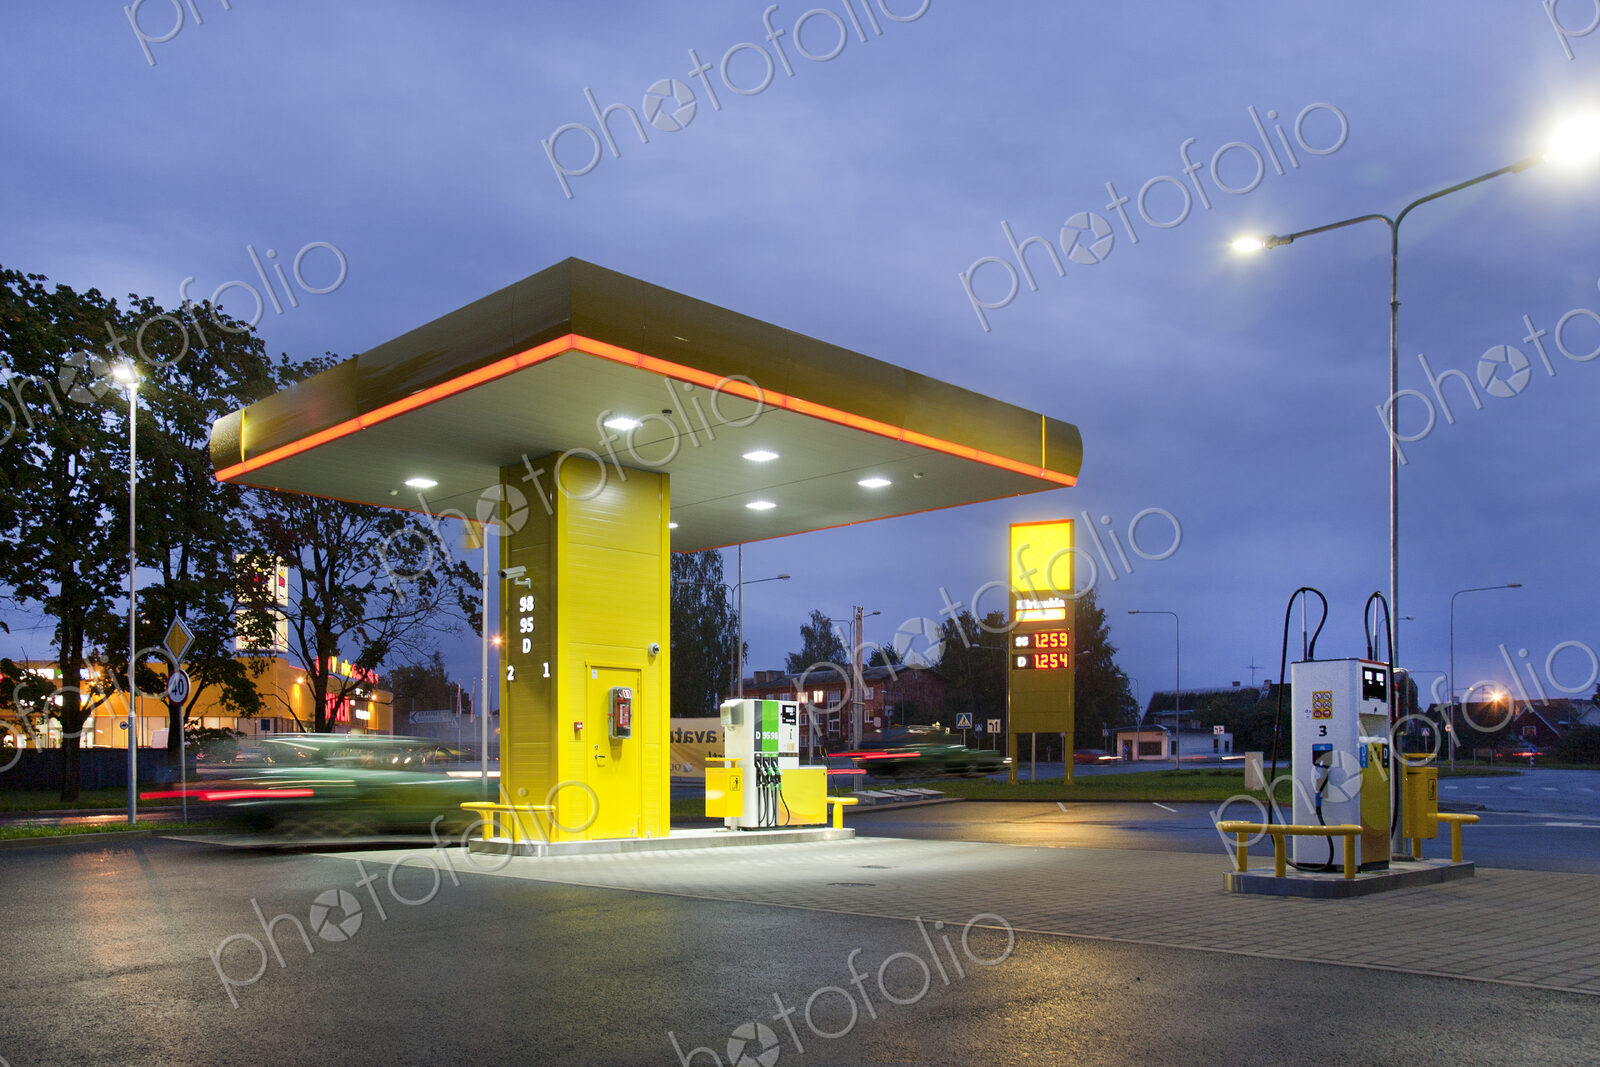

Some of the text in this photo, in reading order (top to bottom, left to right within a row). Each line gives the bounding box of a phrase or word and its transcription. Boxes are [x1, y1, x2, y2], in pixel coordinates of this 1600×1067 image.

[519, 595, 535, 613] 98
[519, 616, 534, 634] 95
[522, 637, 532, 654] D
[1015, 632, 1068, 648] 95 1.259
[542, 661, 551, 678] 1
[1017, 653, 1068, 669] D 1.254
[506, 664, 515, 681] 2
[171, 678, 184, 696] 40
[755, 731, 761, 740] D
[1318, 724, 1328, 737] 3
